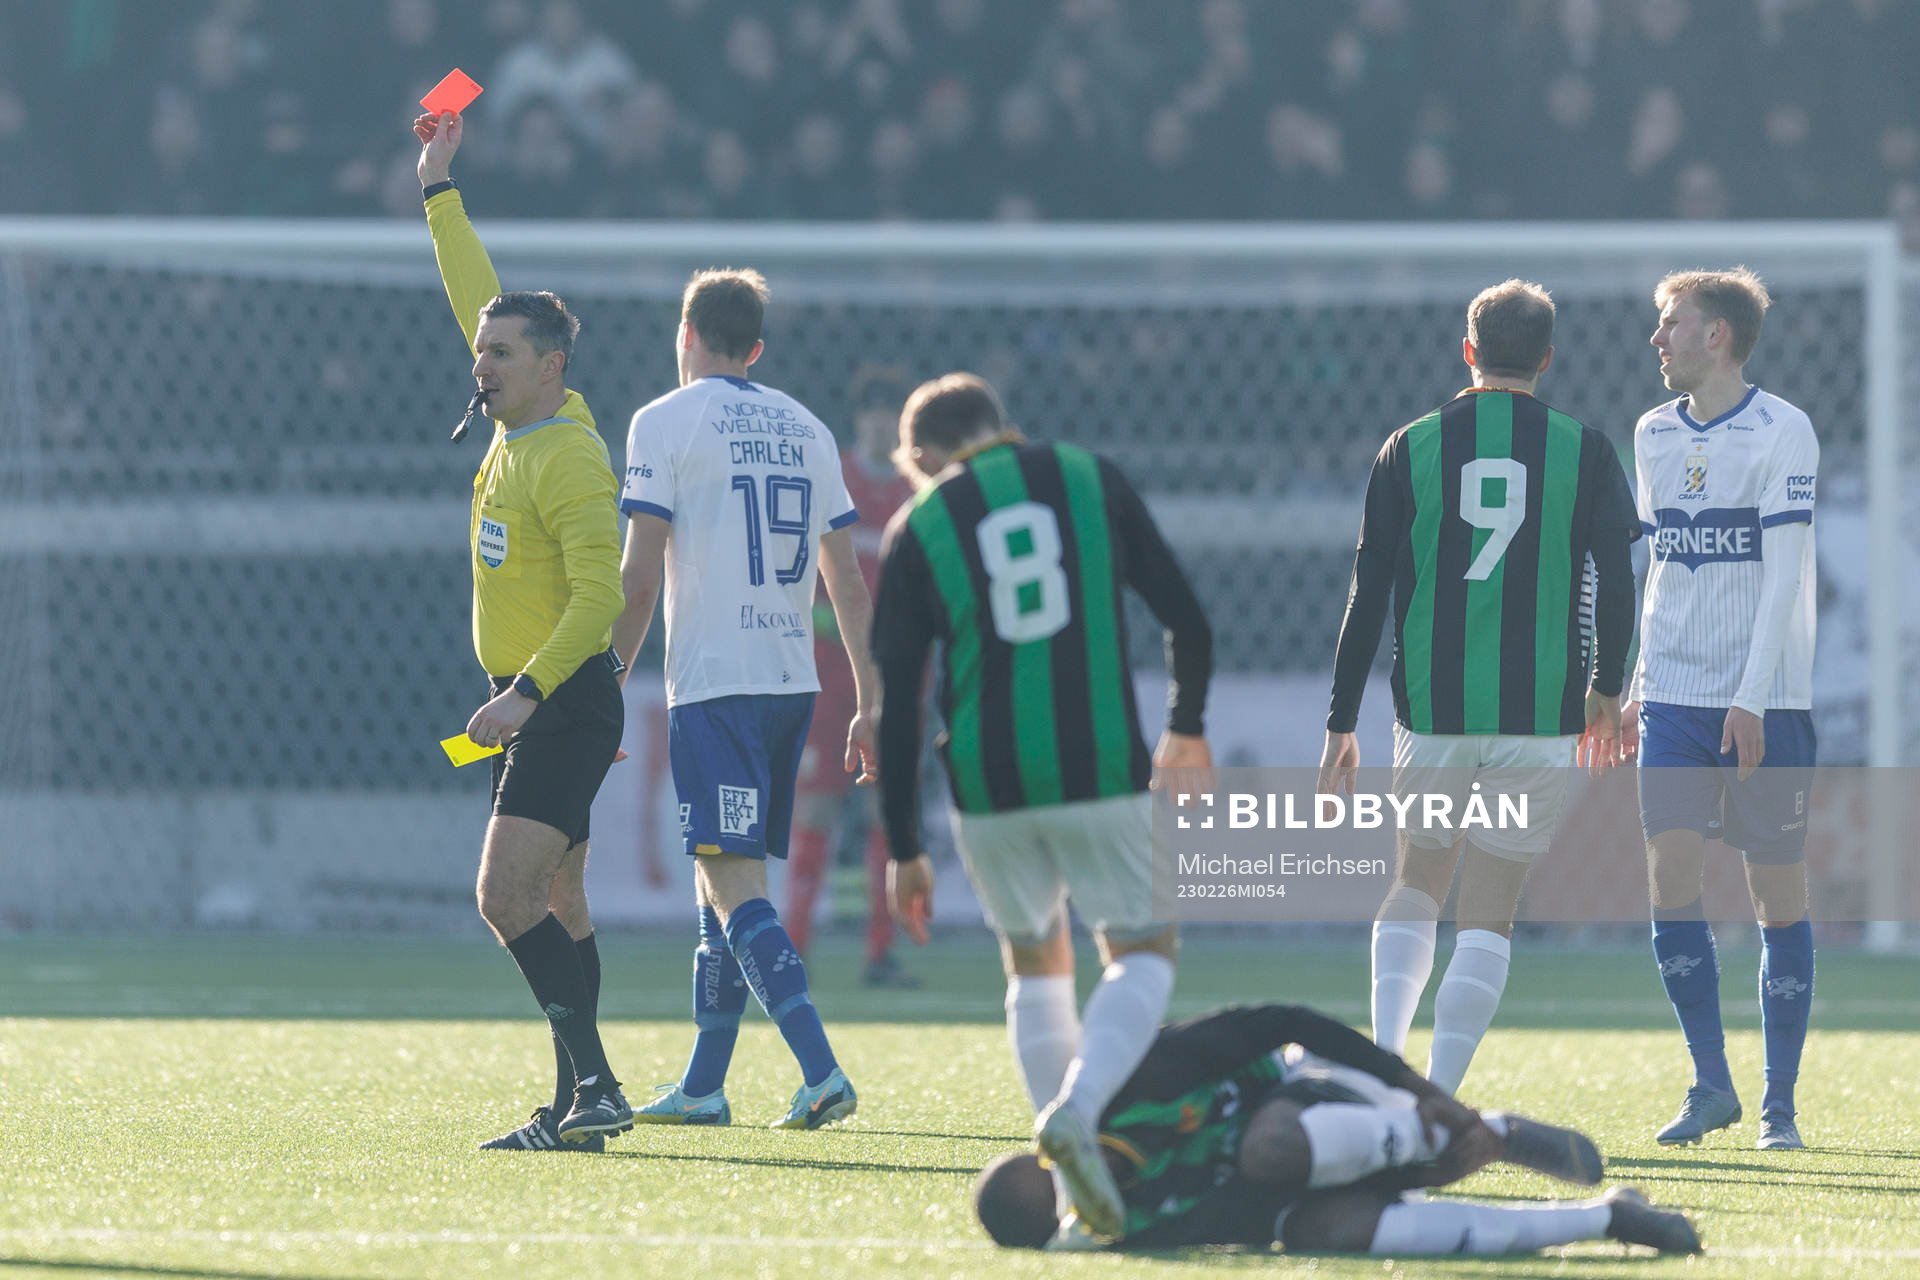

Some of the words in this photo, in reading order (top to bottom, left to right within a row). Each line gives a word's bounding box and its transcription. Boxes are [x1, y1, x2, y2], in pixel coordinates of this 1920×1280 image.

[723, 403, 796, 421] NORDIC
[712, 419, 816, 440] WELLNESS
[730, 440, 804, 467] CARLÉN
[1459, 457, 1527, 581] 9
[482, 521, 504, 538] FIFA
[731, 474, 812, 587] 19
[481, 540, 505, 552] REFEREE
[975, 500, 1072, 644] 8
[721, 788, 750, 805] EFF
[722, 802, 754, 819] EKT
[723, 815, 741, 830] IV
